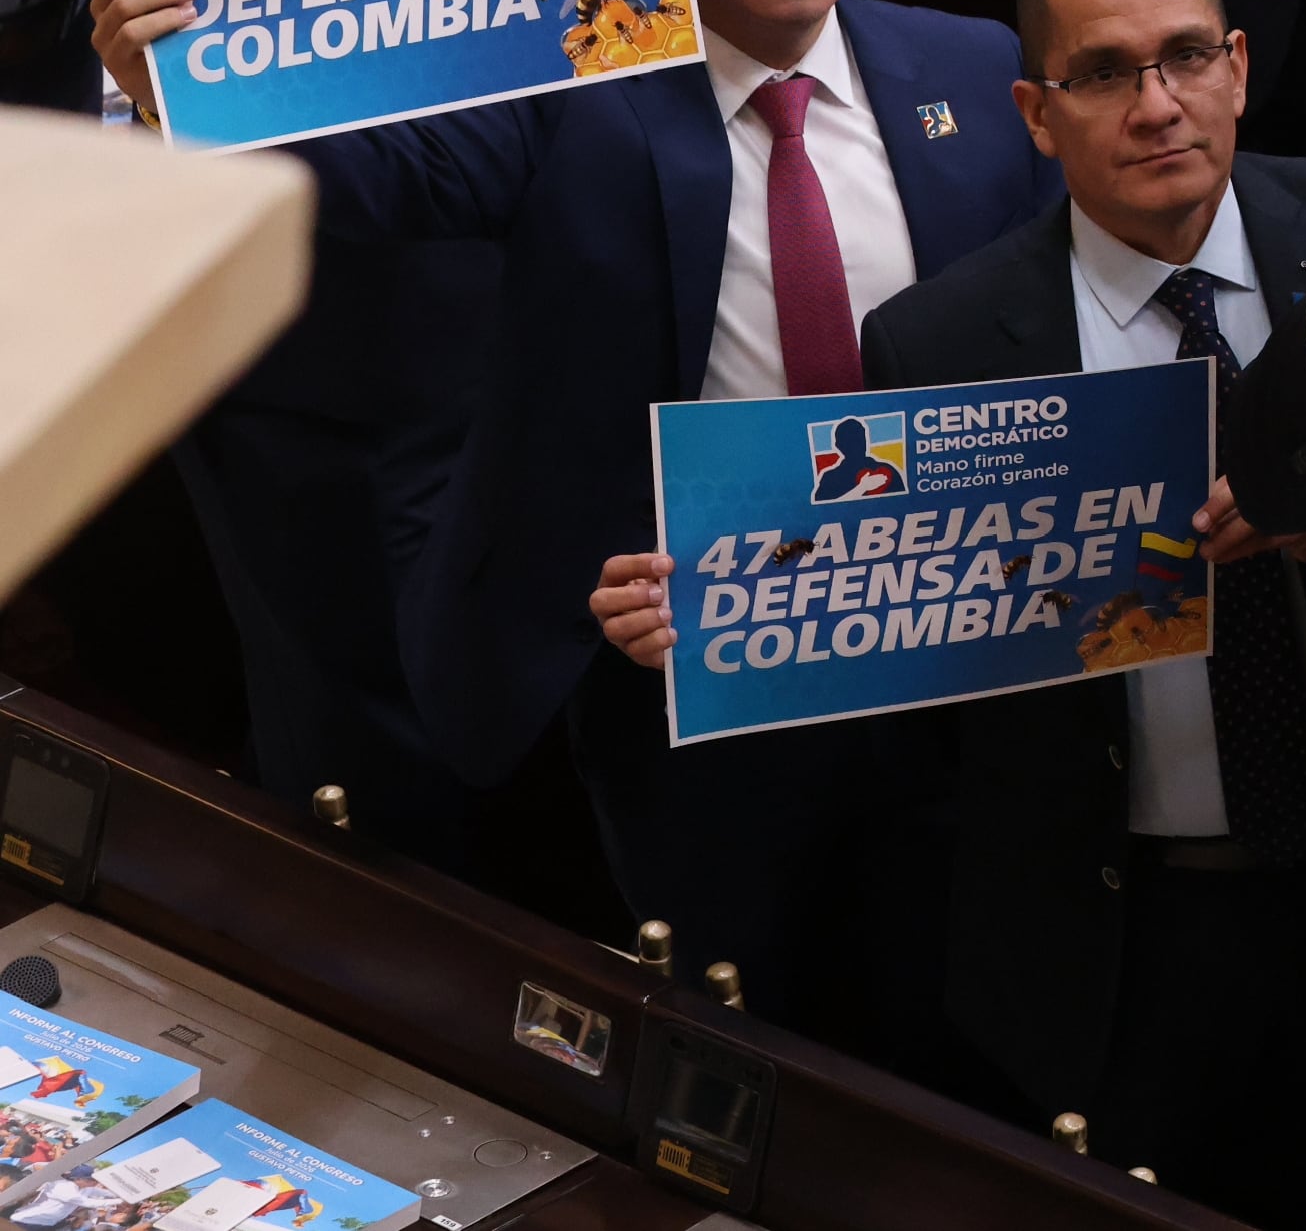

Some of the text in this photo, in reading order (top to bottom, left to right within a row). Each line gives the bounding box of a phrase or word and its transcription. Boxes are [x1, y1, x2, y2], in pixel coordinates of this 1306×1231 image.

[913, 395, 1068, 435] CENTRO
[916, 424, 1068, 455] DEMOCRÁTICO
[917, 451, 1024, 475] Mano firme
[917, 462, 1069, 493] Corazón grande
[696, 482, 1165, 579] 47 ABEJAS EN
[700, 533, 1118, 629] DEFENSA DE
[704, 591, 1062, 674] COLOMBIA
[9, 1008, 142, 1063] INFORME AL CONGRESO
[24, 1034, 90, 1062] GUSTAVO PETRO
[236, 1123, 364, 1186] INFORME AL CONGRESO
[249, 1150, 312, 1182] GUSTAVO PETRO
[284, 1154, 294, 1163] de
